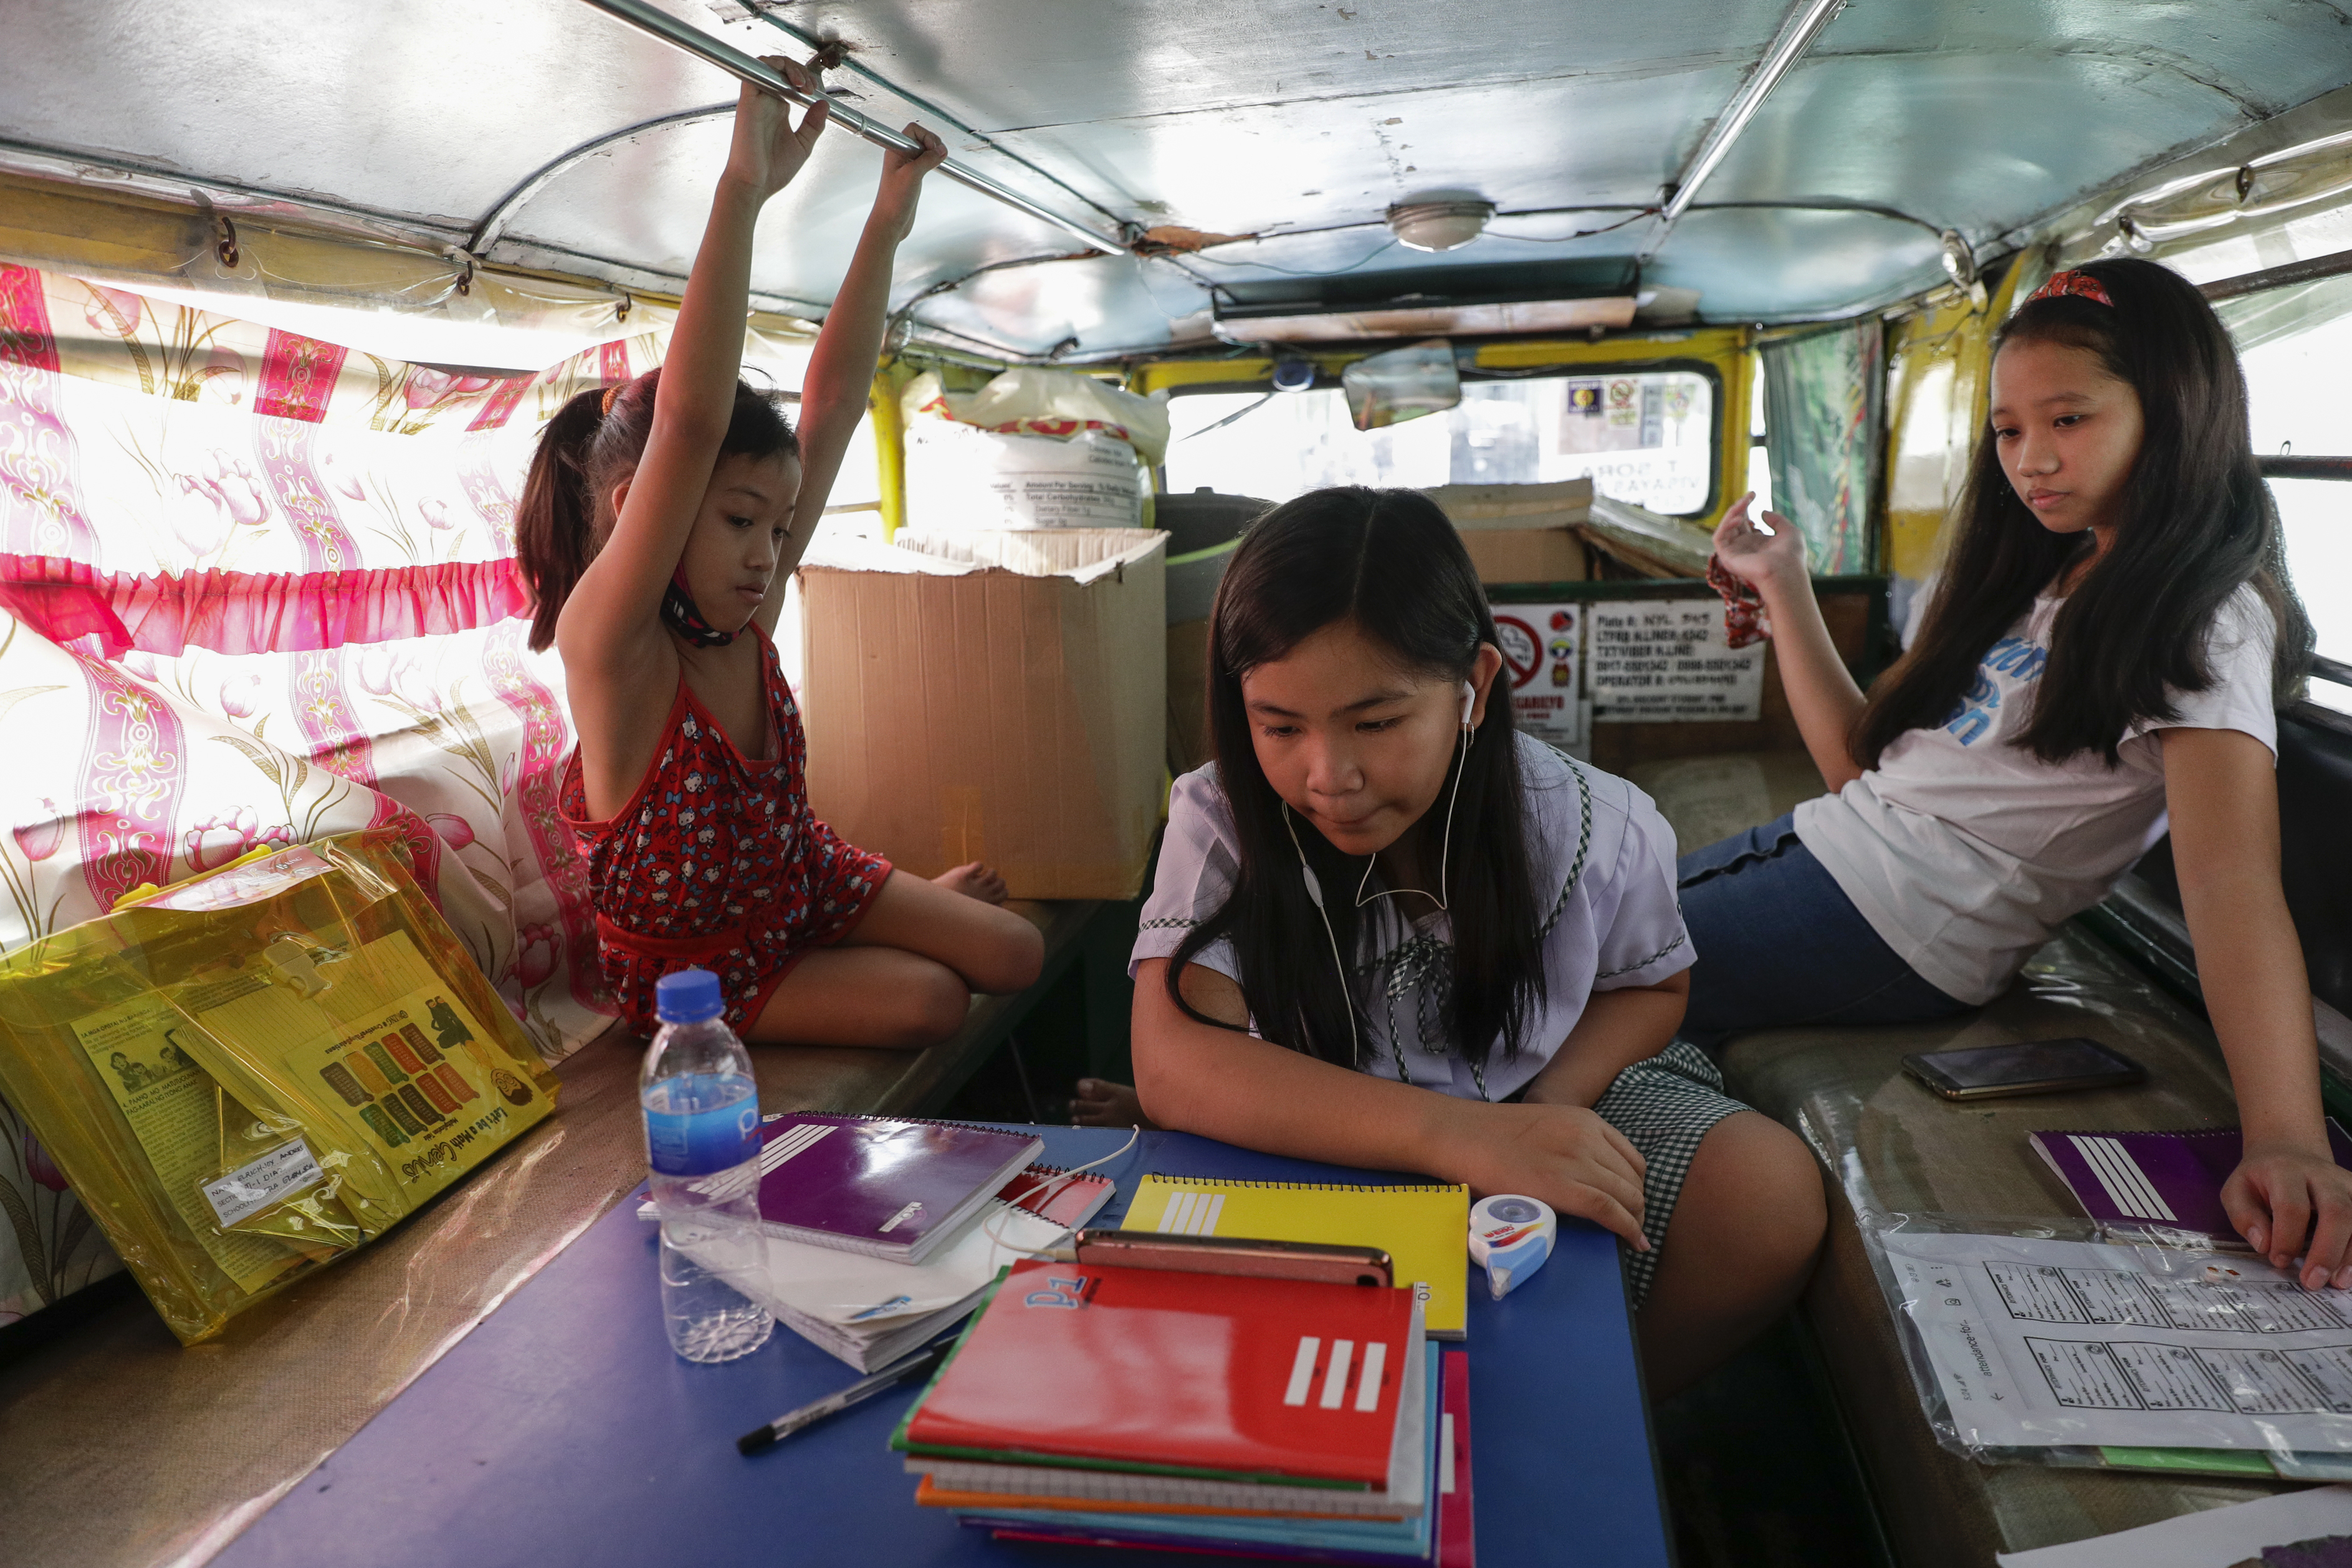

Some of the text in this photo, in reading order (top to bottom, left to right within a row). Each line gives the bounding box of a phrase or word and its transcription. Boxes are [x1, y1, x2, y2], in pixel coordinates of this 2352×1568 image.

[128, 1093, 148, 1106] PAANO
[150, 1088, 160, 1096] MO
[155, 1094, 165, 1103] NG
[183, 1079, 198, 1090] ANAK
[402, 1106, 508, 1183] Let's be a Math Genius
[1994, 1273, 2017, 1303] ATTENDANCE FORM
[2037, 1352, 2048, 1362] FORM
[2121, 1357, 2133, 1367] FORM
